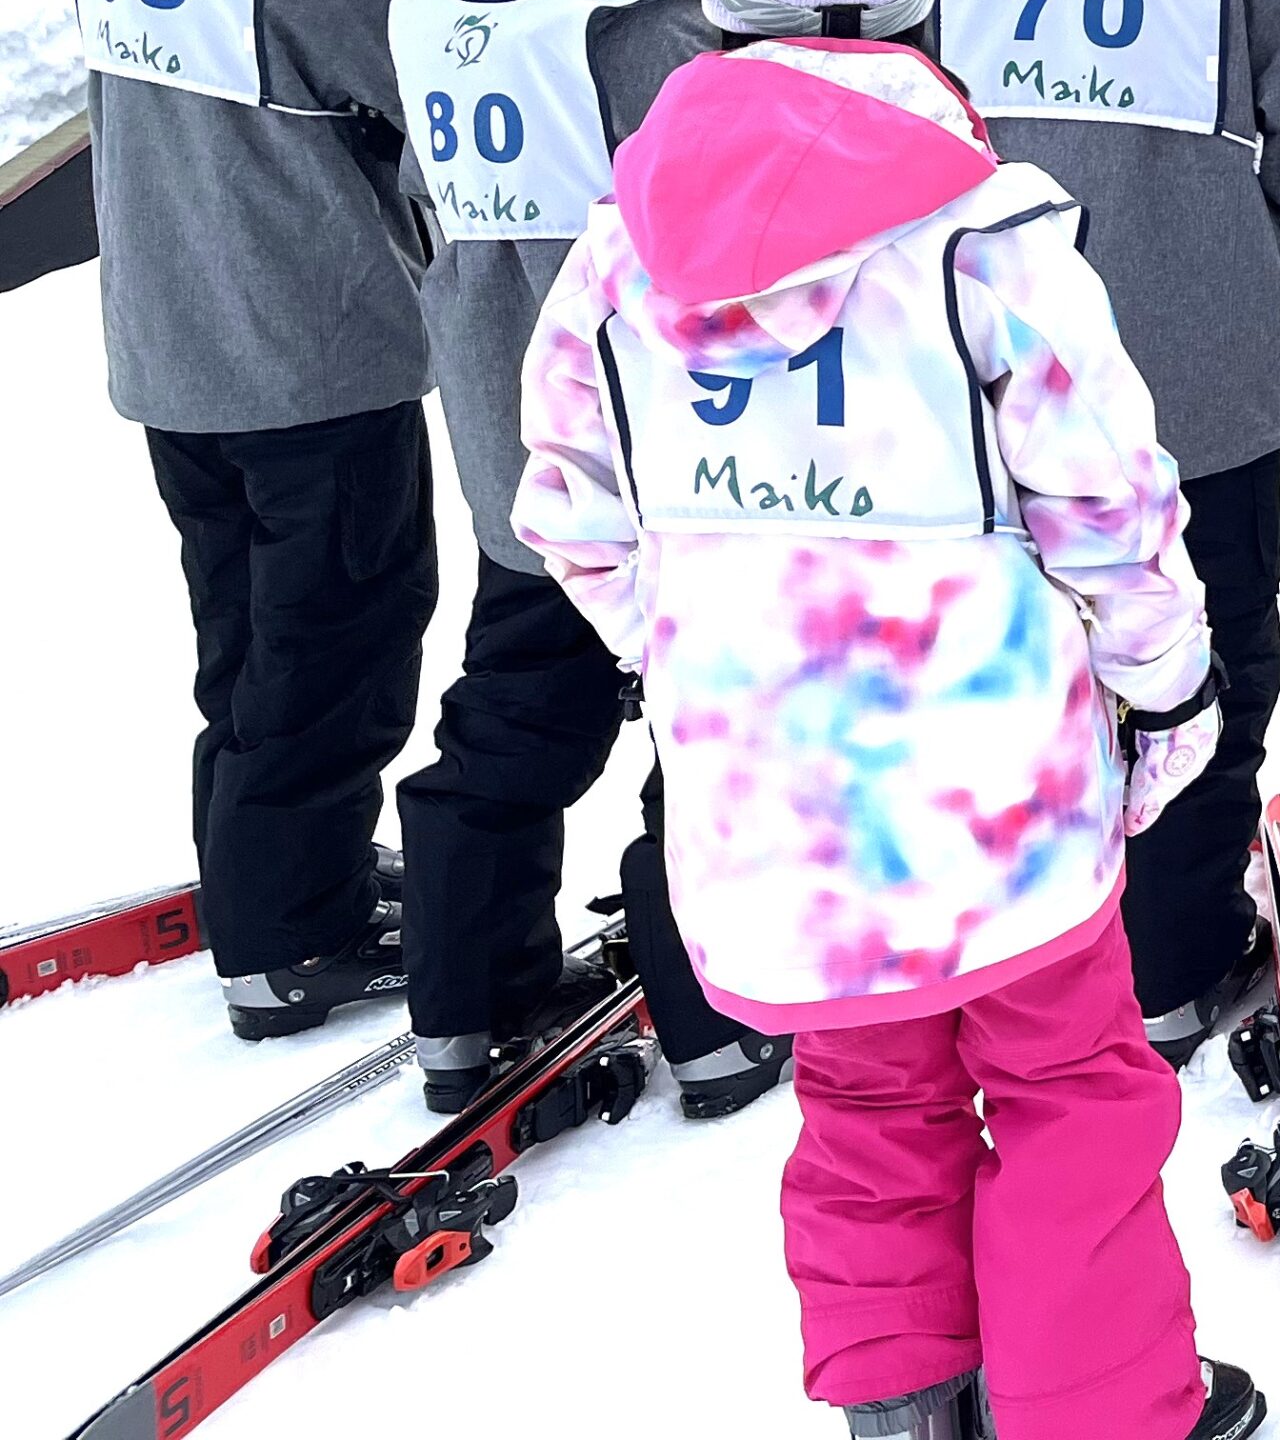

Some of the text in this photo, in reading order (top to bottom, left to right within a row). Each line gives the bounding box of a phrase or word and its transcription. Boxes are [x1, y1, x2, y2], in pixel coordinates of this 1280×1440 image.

[96, 20, 180, 74] Maiko
[1003, 61, 1134, 108] Maiko
[425, 91, 524, 163] 80
[437, 181, 541, 222] Maiko
[694, 456, 873, 517] Maiko
